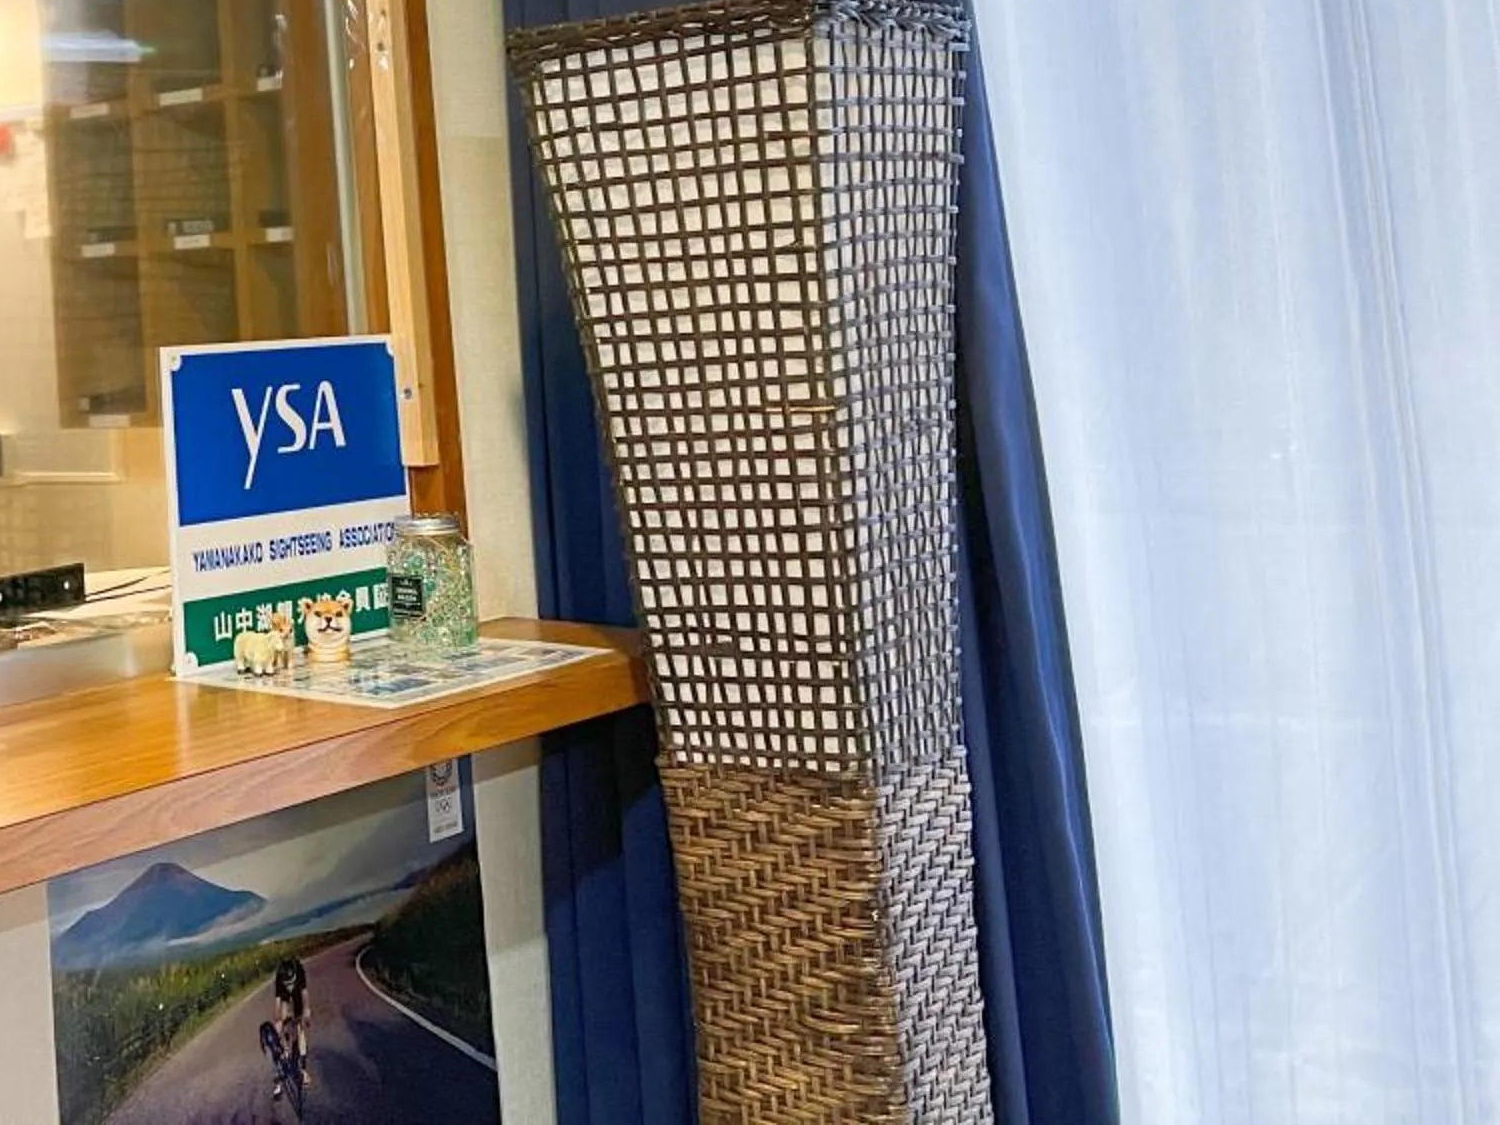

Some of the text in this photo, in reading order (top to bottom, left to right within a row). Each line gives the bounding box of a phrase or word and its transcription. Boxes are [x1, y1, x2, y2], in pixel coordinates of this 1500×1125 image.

[192, 522, 396, 573] YAMANAKAKO SIGHTSEEING ASSOCIATIO
